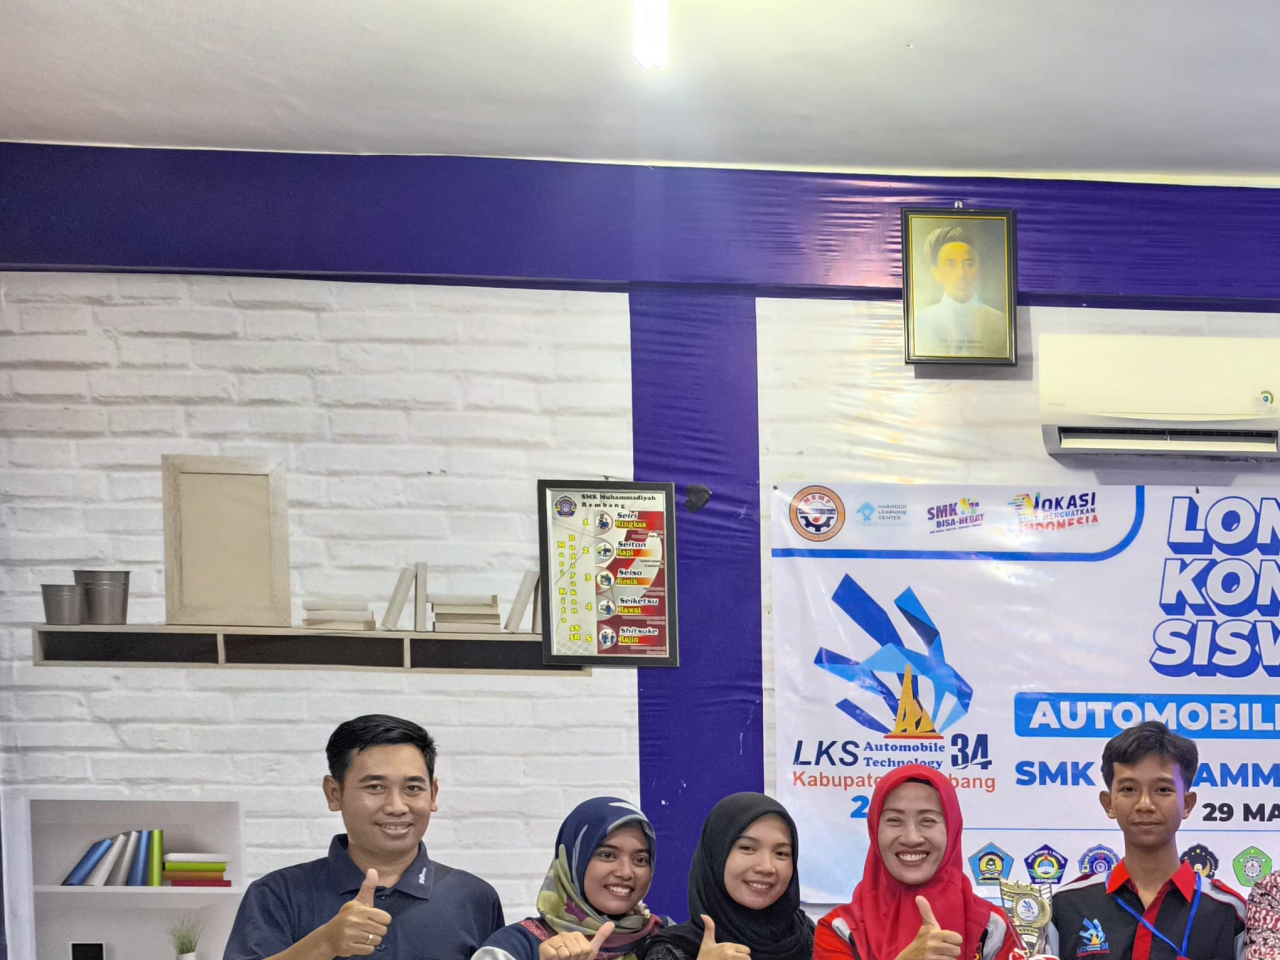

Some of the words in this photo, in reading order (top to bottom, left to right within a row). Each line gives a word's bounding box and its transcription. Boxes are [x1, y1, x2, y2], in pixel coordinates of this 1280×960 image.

[927, 502, 958, 521] SMK
[615, 520, 647, 529] Ringkas
[617, 540, 647, 548] Seiton
[616, 548, 634, 557] Rapi
[618, 569, 643, 577] Seiso
[619, 597, 658, 605] Seiketsu
[620, 627, 658, 635] Shitsuke
[619, 635, 639, 644] Rajin
[863, 741, 945, 753] Automobile
[951, 733, 992, 770] 34
[793, 739, 860, 767] LKS
[1015, 760, 1096, 786] SMK
[1202, 802, 1235, 822] 29
